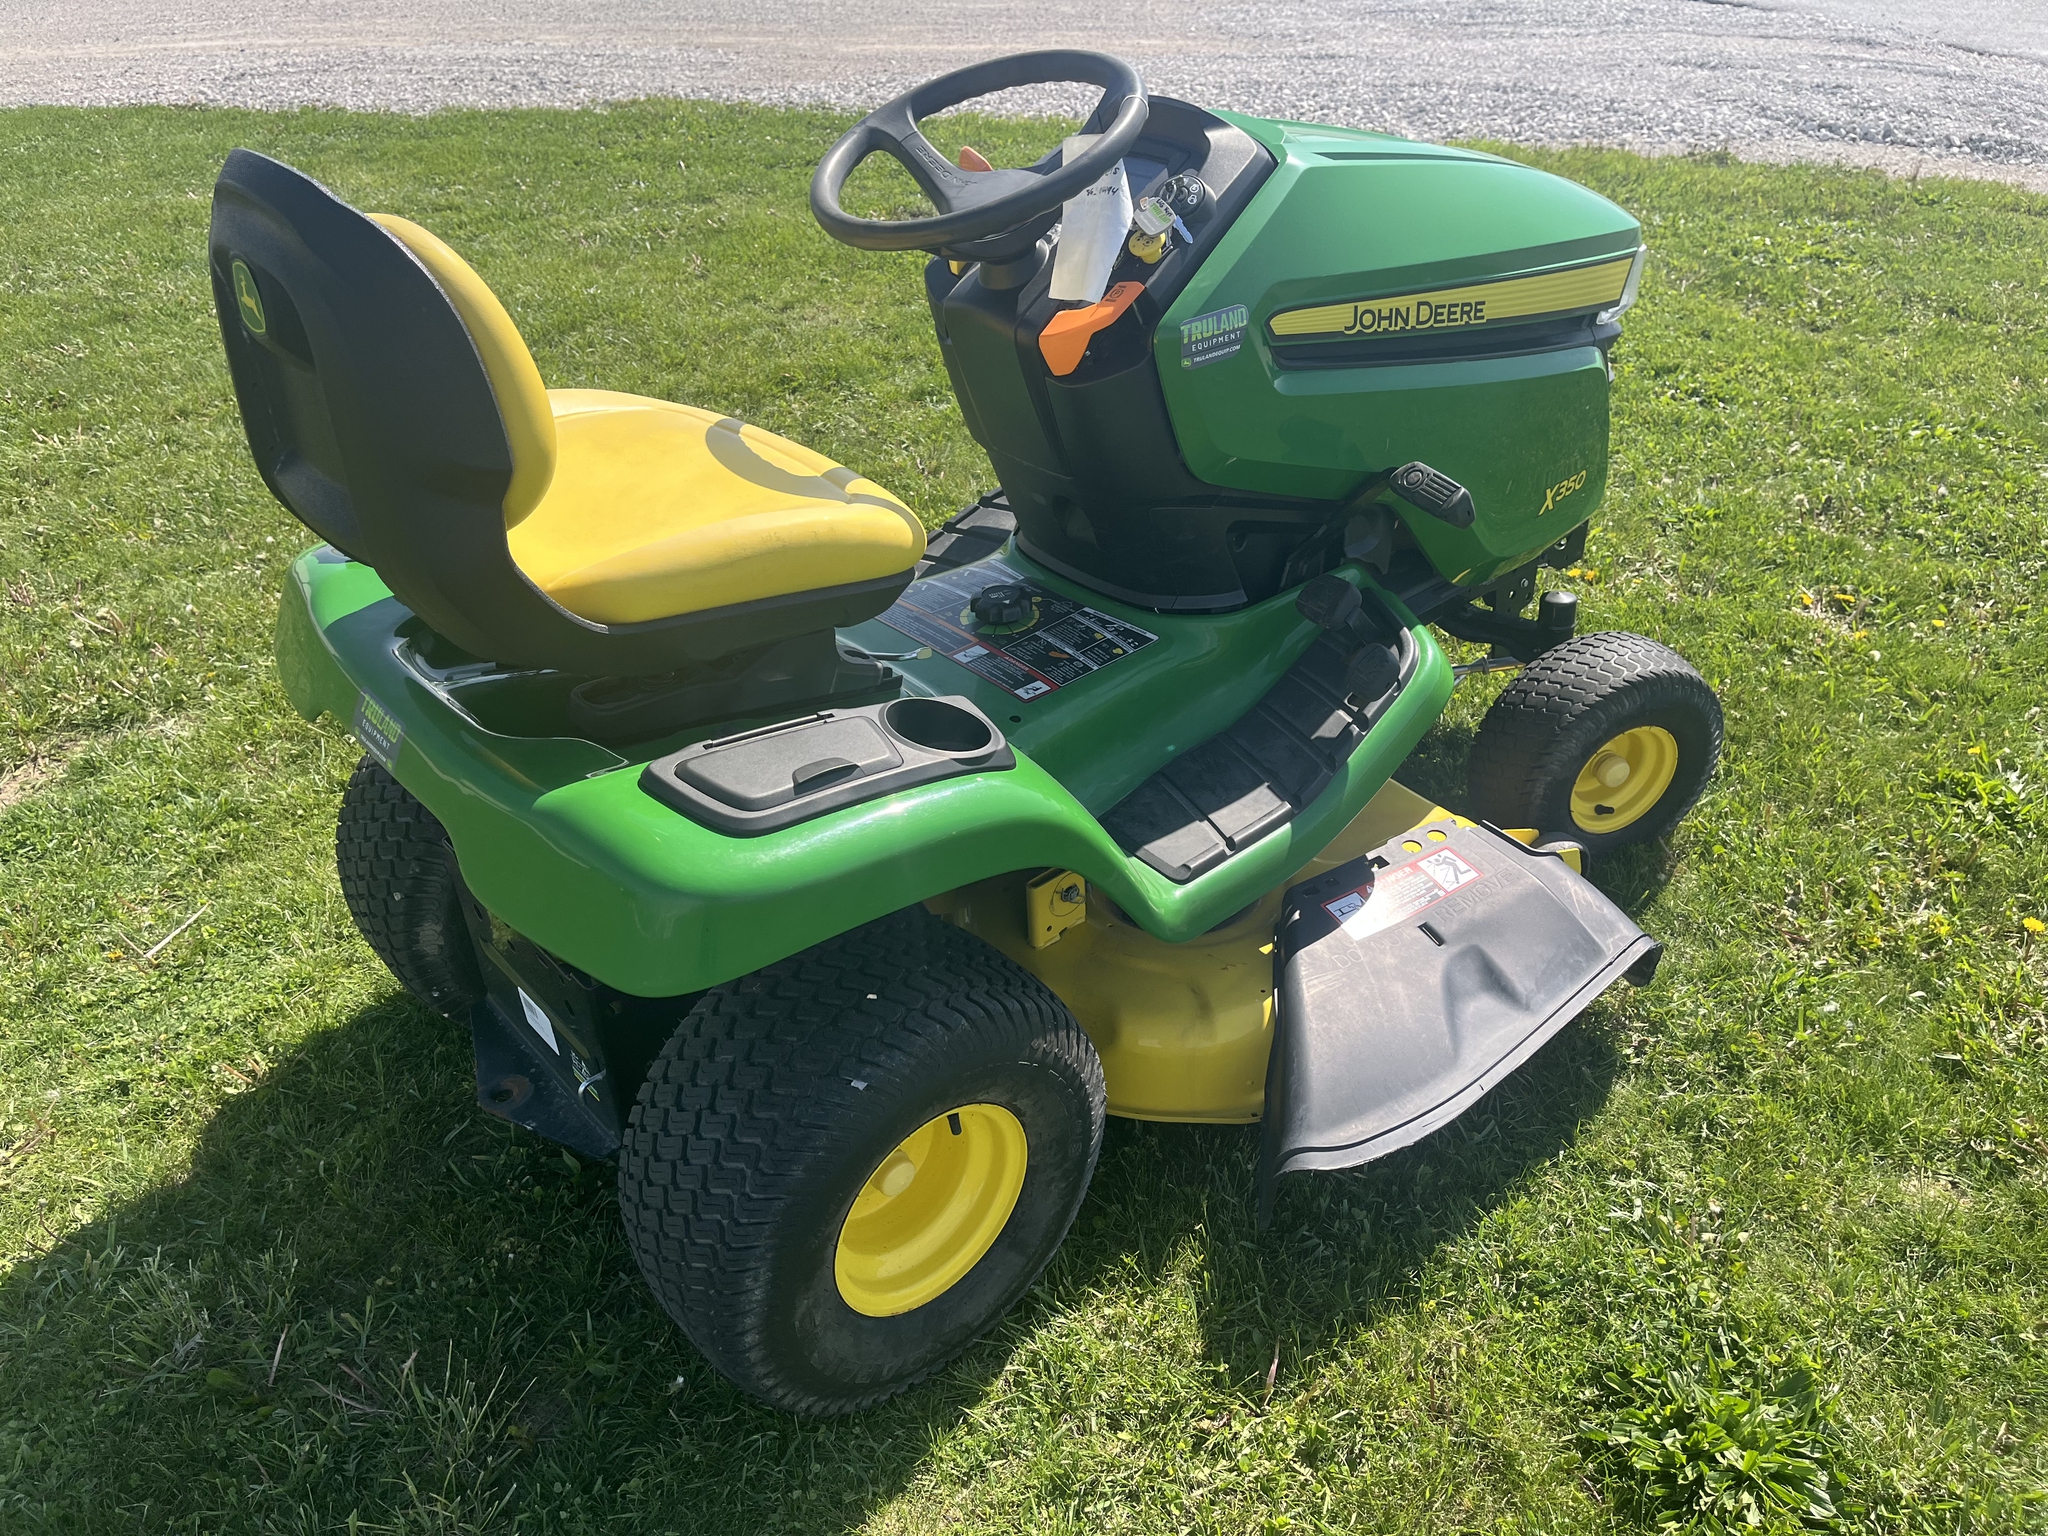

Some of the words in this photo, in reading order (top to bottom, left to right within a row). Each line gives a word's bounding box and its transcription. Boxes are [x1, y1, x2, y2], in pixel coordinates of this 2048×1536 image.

[915, 145, 953, 180] DEERE
[1180, 307, 1247, 344] TRULAND
[1343, 304, 1411, 334] JOHN
[1415, 300, 1487, 328] DEERE
[1191, 330, 1241, 352] EQUIPMENT
[1193, 344, 1241, 363] TRULANDEQUIP.COM
[1538, 469, 1587, 516] X350
[361, 693, 402, 744] TRULAND
[362, 718, 390, 750] EQUIPMENT
[1331, 949, 1364, 969] DO
[1432, 868, 1520, 923] REMOVE
